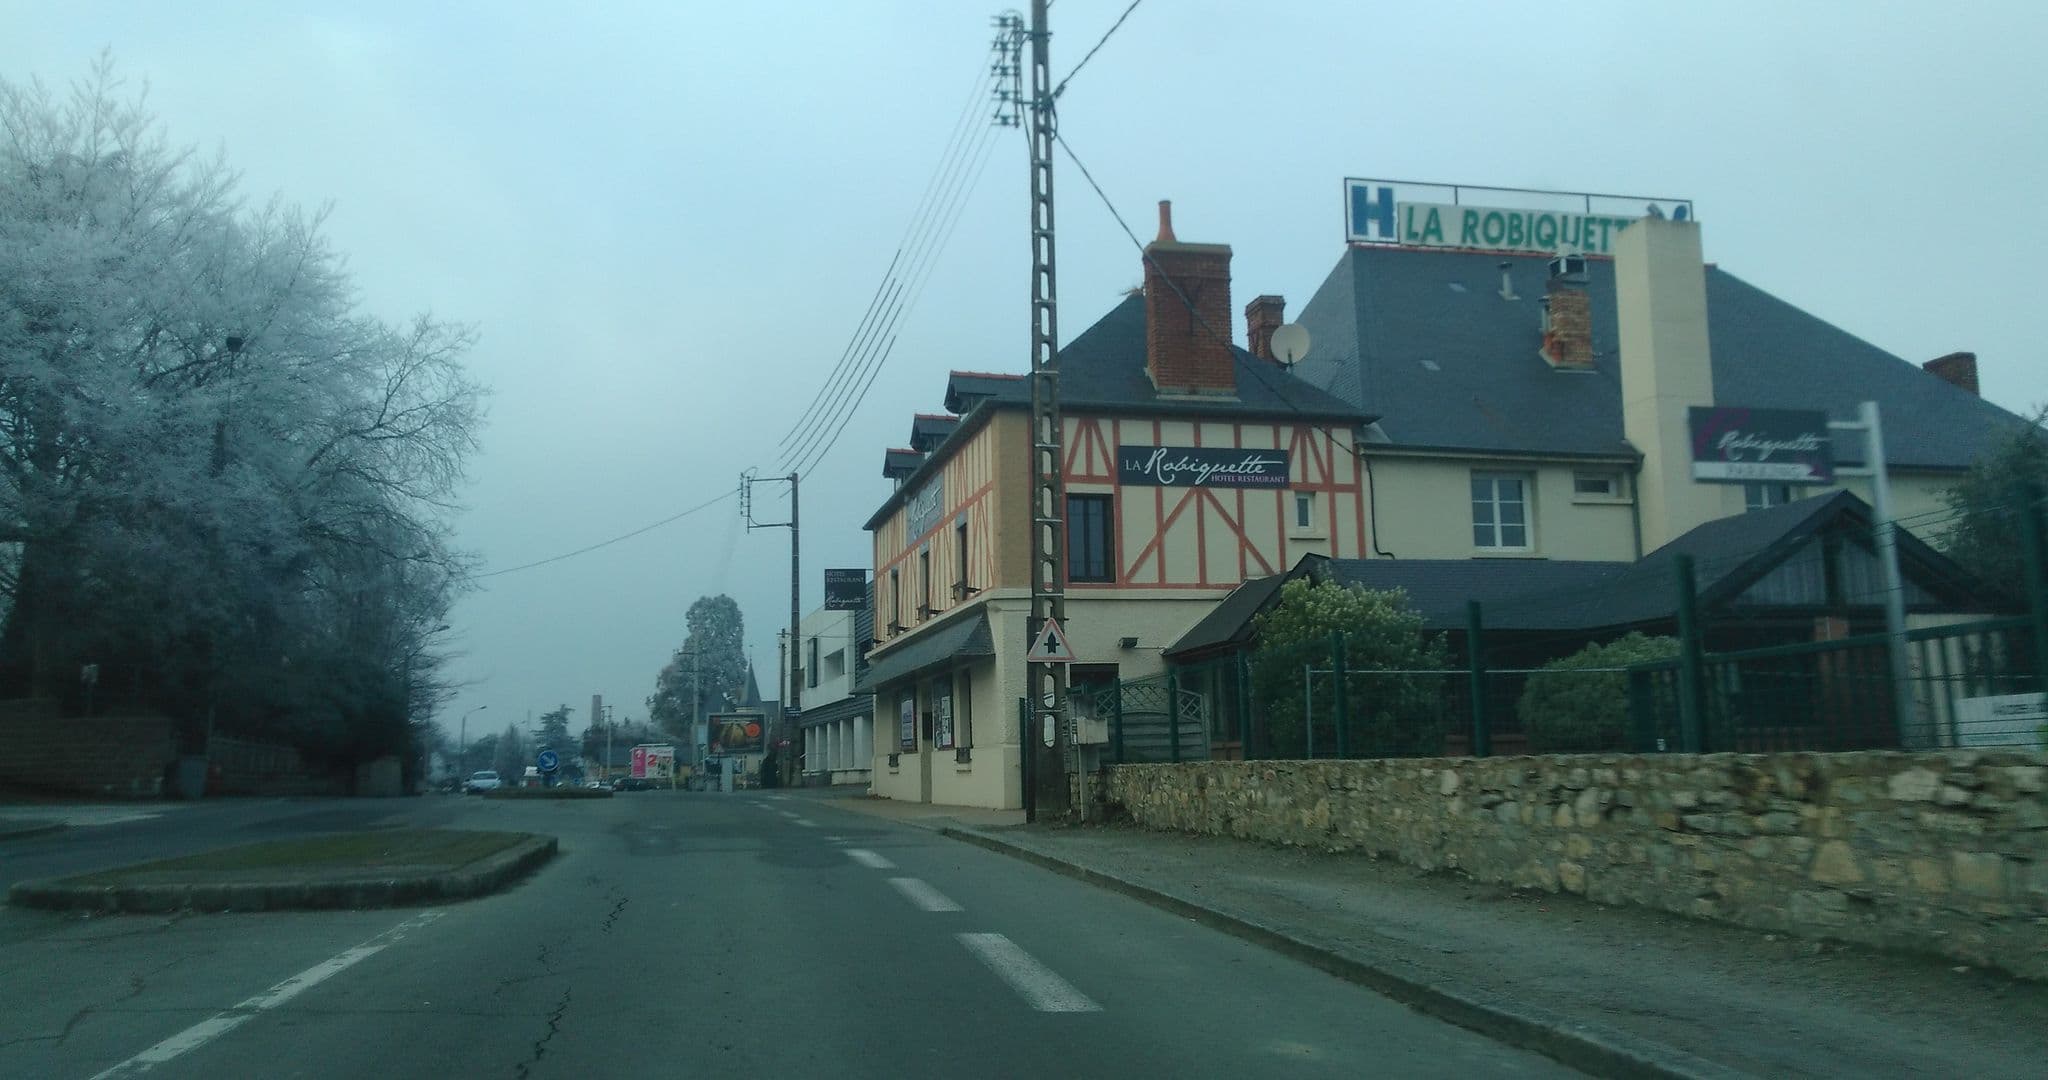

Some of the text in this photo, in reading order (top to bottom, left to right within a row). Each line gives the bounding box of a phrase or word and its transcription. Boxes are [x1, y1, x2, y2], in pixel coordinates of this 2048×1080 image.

[1352, 185, 1394, 236] H
[1405, 206, 1638, 253] LA ROBIQUETT
[1125, 447, 1284, 485] LA Robiquette
[1211, 475, 1285, 484] HOTEL RESTAURANT
